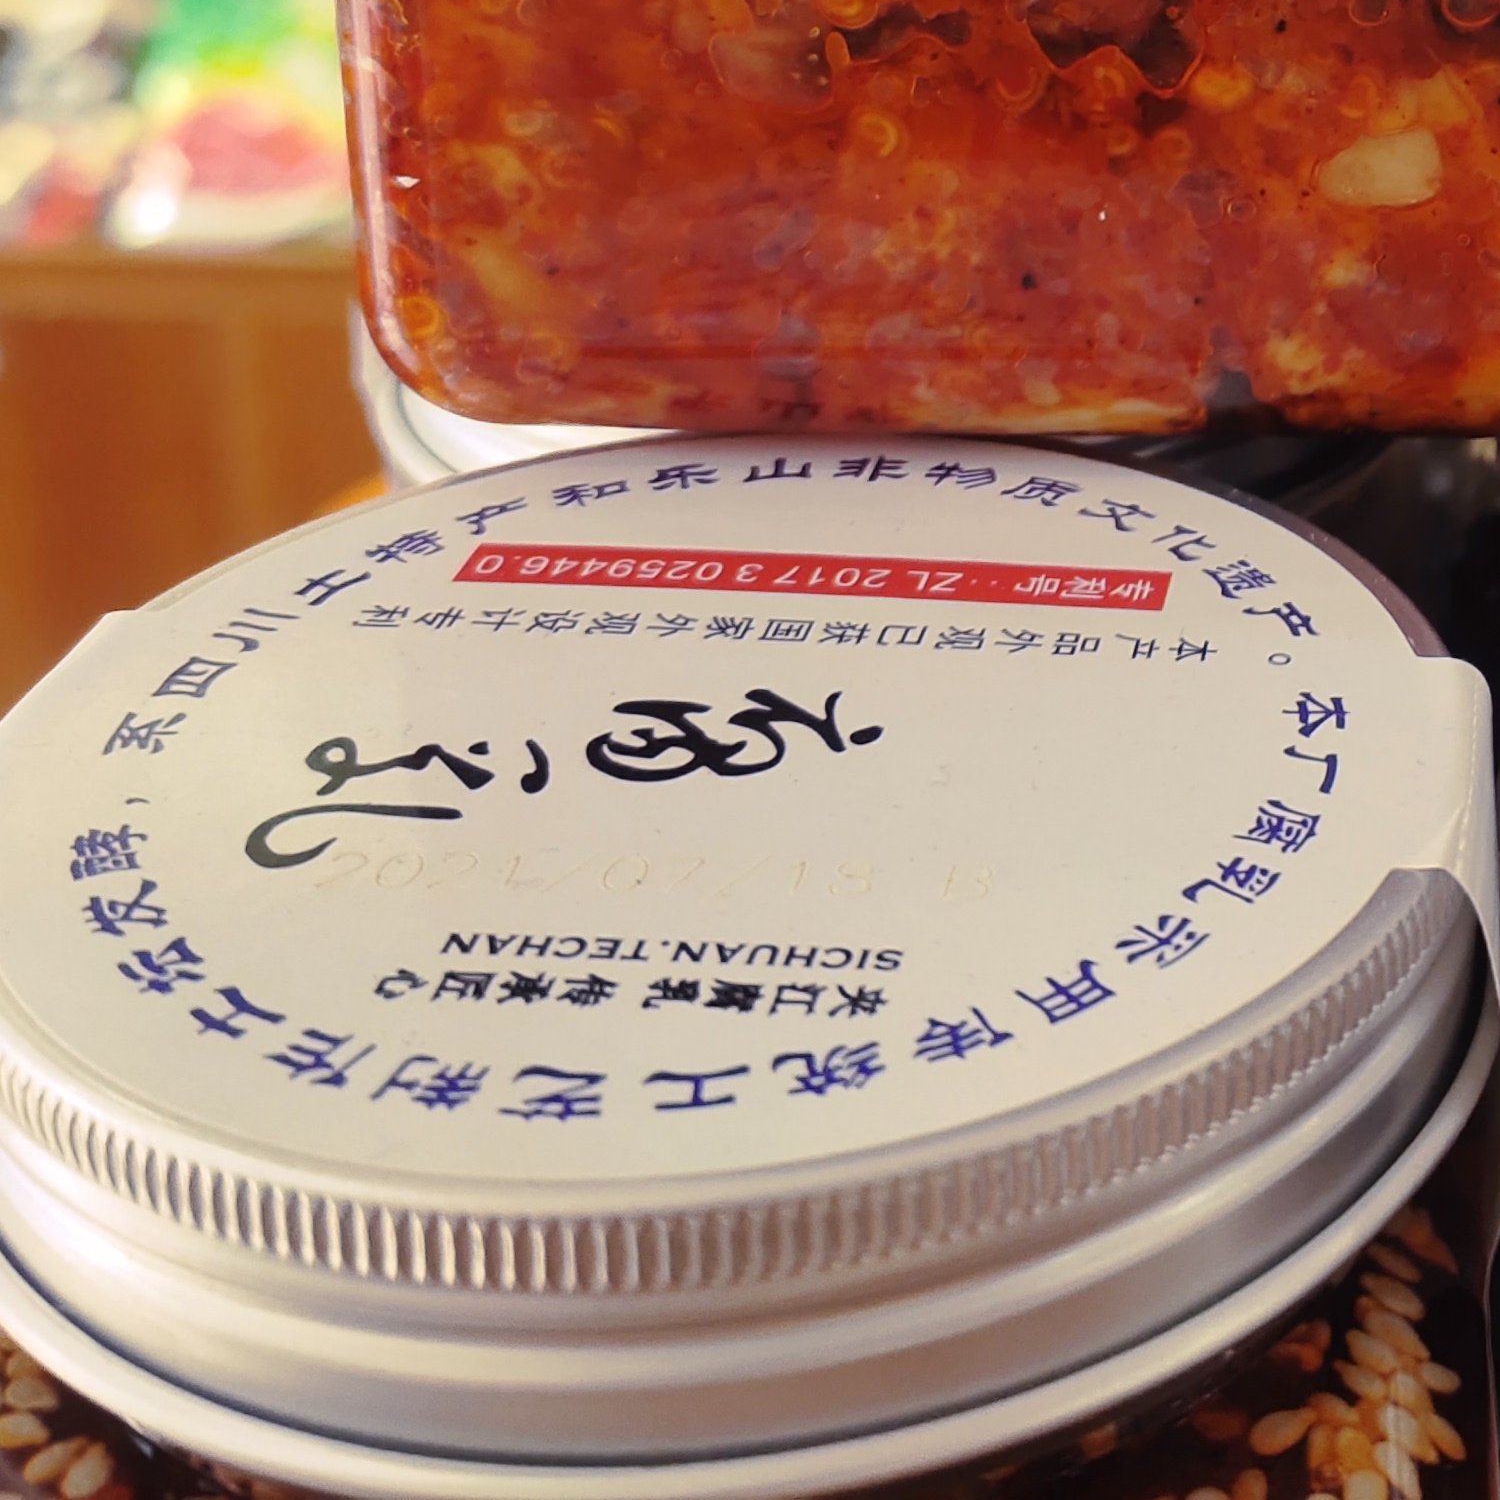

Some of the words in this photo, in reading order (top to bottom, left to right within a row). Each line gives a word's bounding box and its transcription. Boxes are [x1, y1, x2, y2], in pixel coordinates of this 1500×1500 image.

[475, 554, 723, 580] 0259446.0
[738, 562, 763, 581] 3
[772, 564, 890, 587] 2017
[908, 571, 963, 592] ZL
[353, 605, 1217, 664] 本产品外观已获国家外观设计专利
[438, 933, 903, 971] SICHUAN.TECHAN
[371, 968, 620, 1008] 传承匠心
